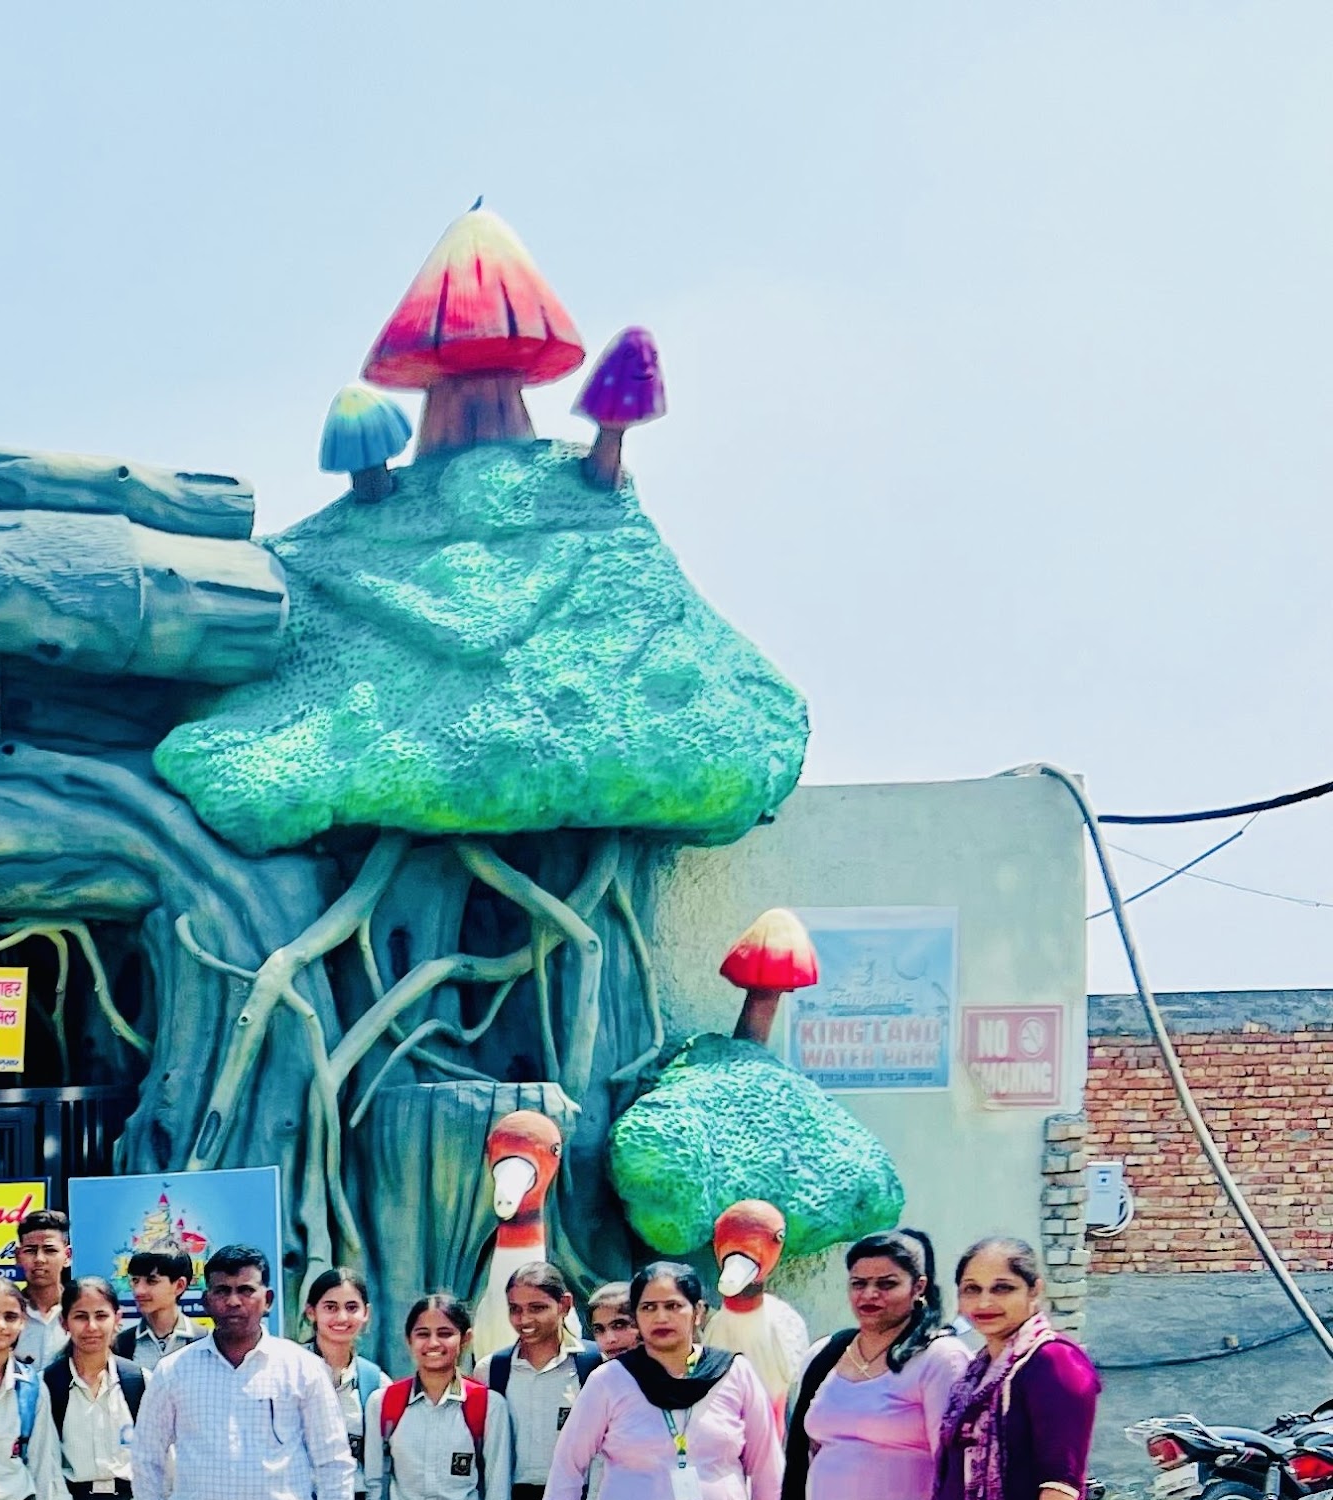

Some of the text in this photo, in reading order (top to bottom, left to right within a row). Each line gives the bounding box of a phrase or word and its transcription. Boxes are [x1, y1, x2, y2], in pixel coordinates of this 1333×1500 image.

[799, 1019, 865, 1045] KING
[978, 1018, 1009, 1058] NO
[801, 1048, 875, 1069] WATER
[970, 1061, 1053, 1094] SMOKING
